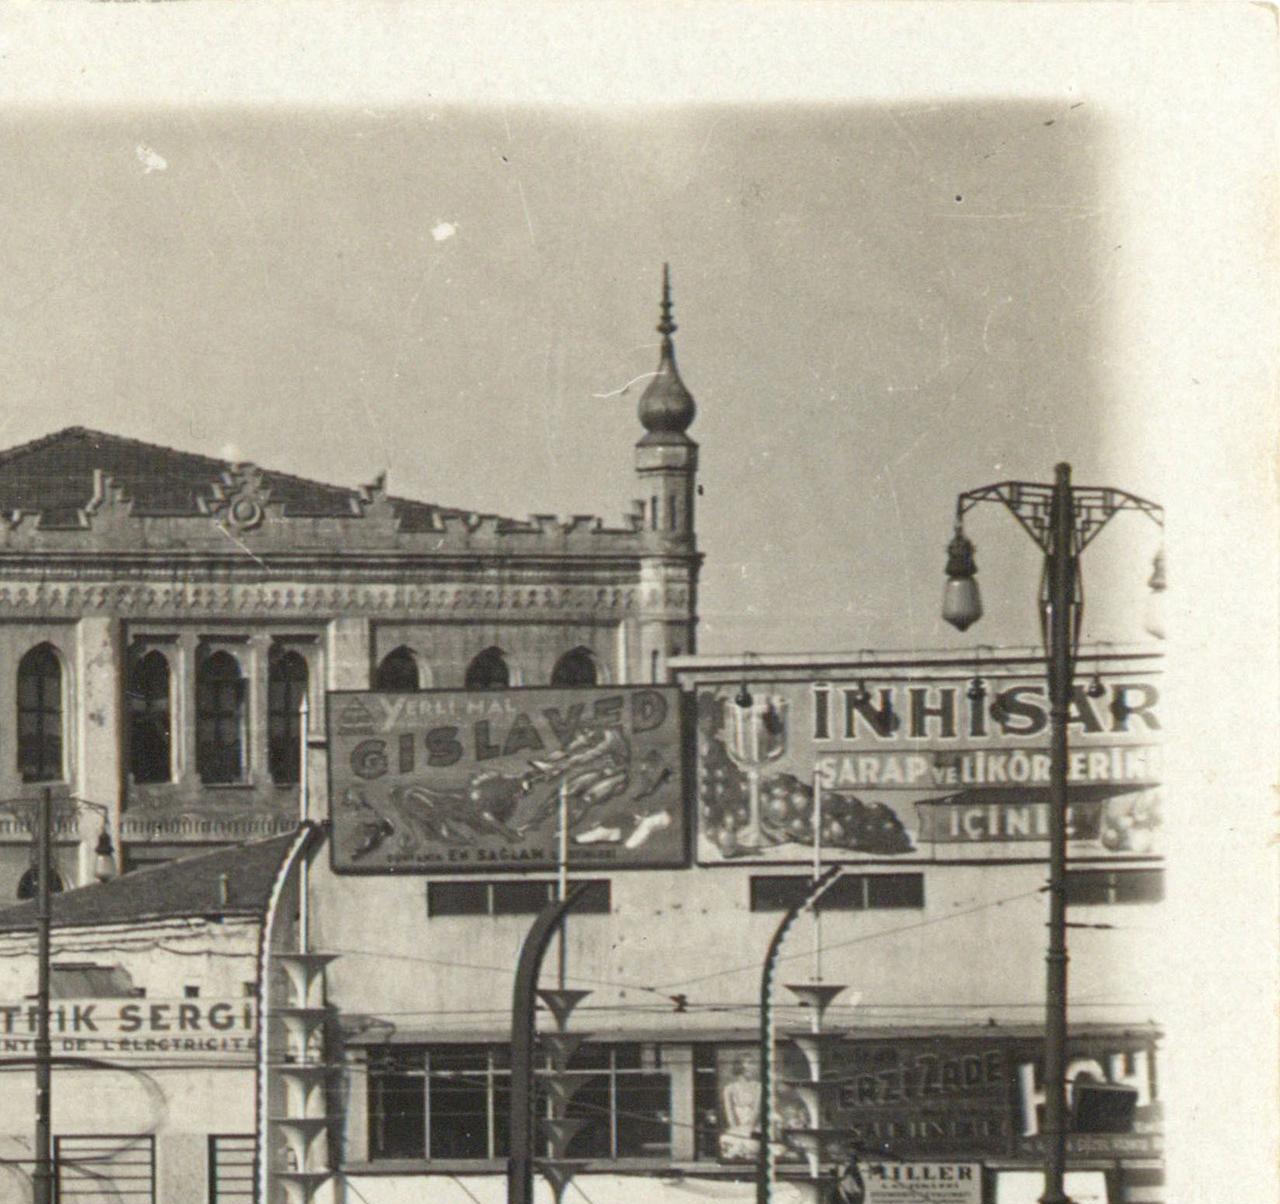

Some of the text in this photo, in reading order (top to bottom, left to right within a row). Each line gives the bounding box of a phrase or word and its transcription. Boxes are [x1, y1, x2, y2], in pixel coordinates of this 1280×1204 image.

[349, 690, 668, 780] GISLAVED
[813, 682, 1162, 741] İNHİSAR
[64, 1038, 87, 1051] DE
